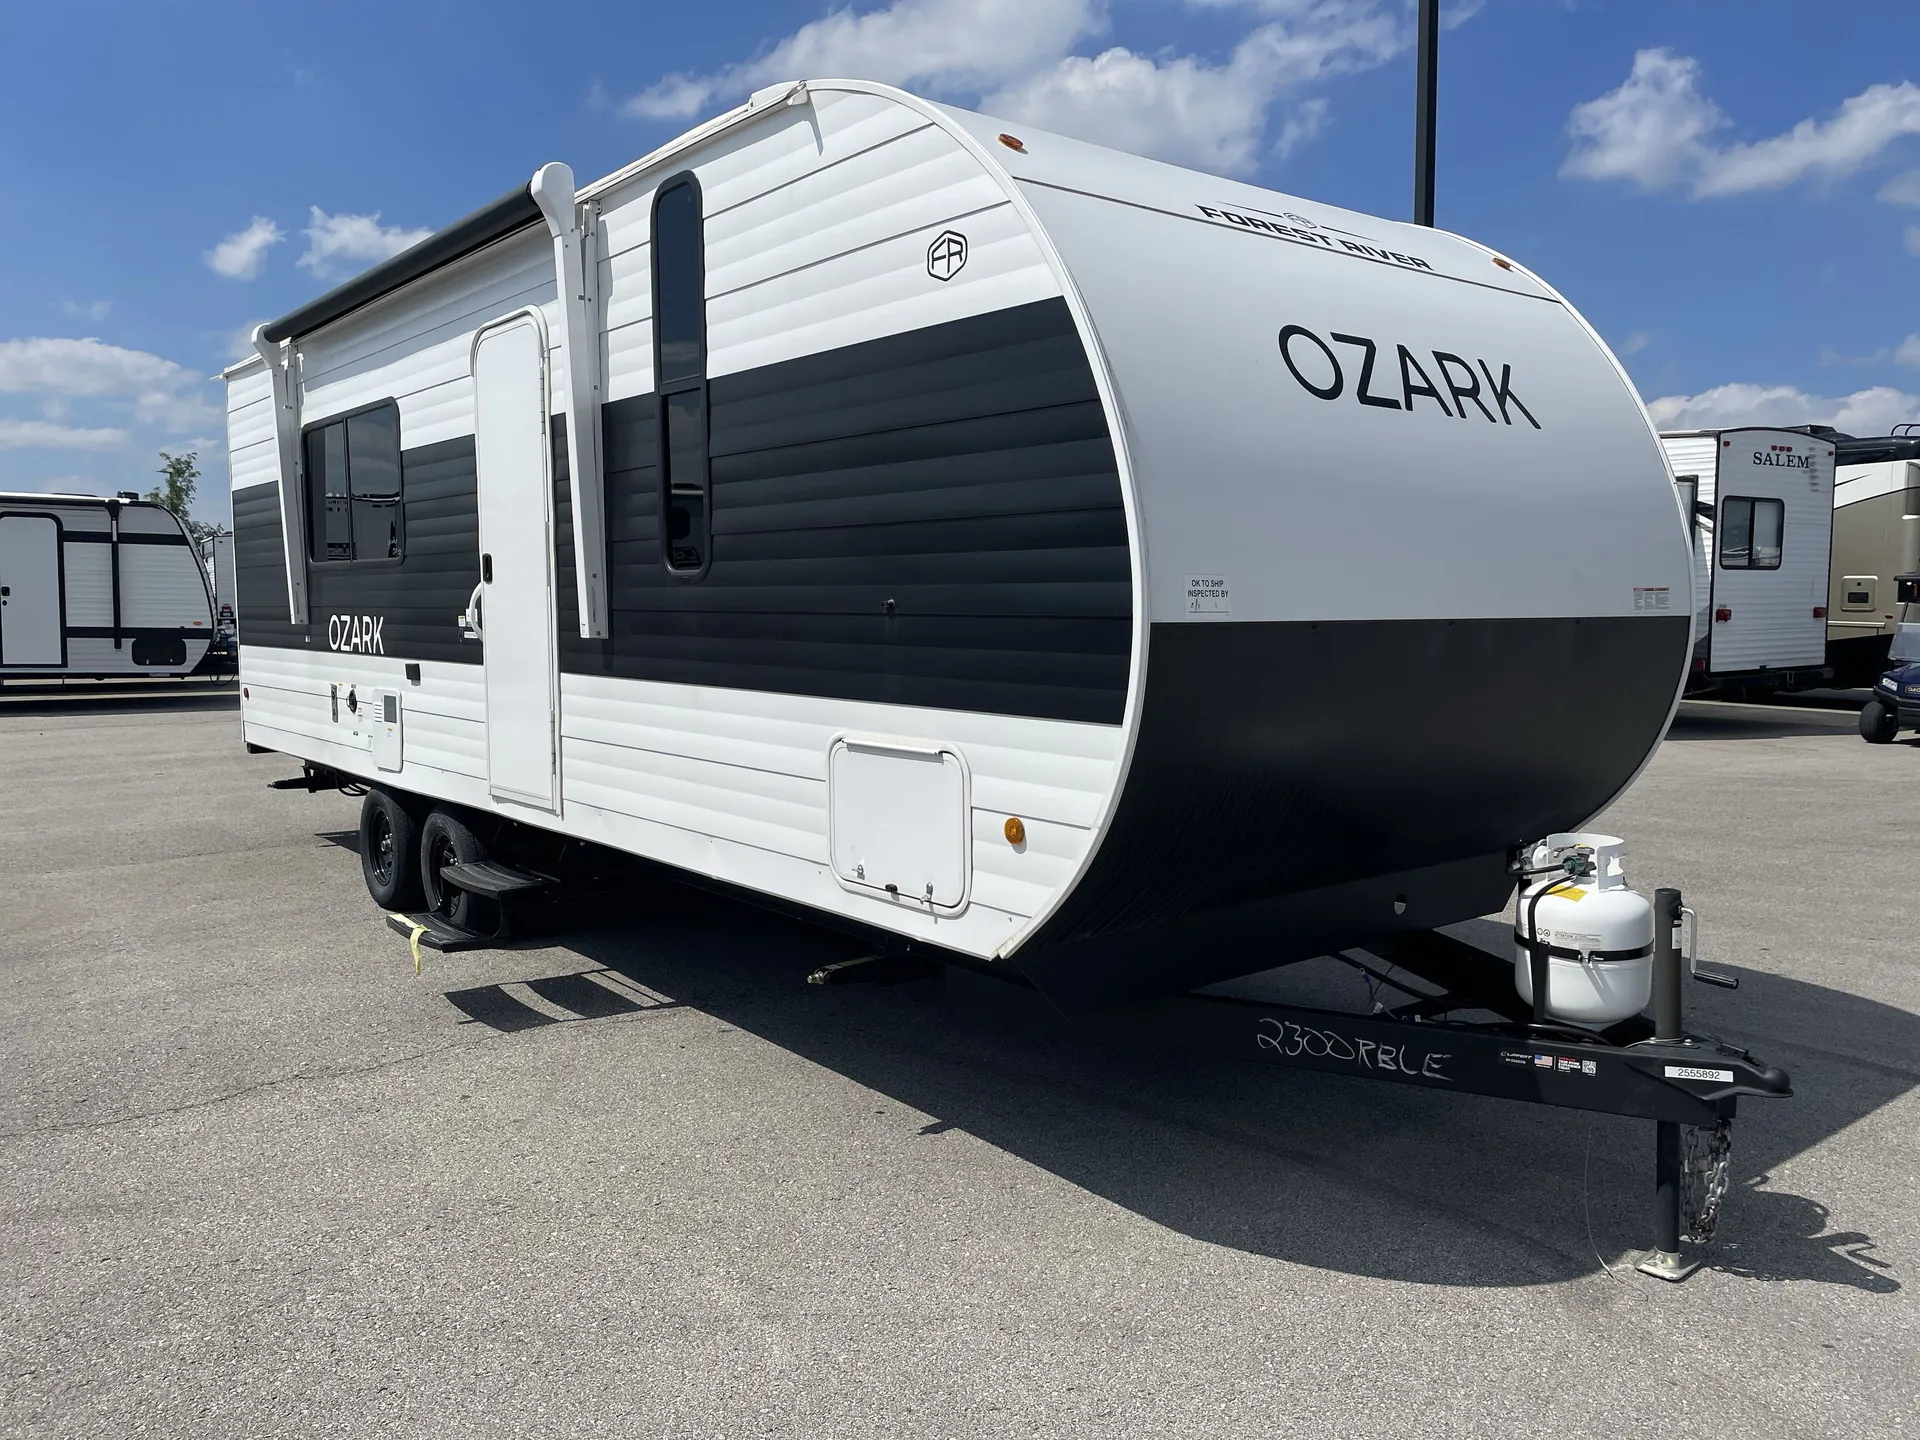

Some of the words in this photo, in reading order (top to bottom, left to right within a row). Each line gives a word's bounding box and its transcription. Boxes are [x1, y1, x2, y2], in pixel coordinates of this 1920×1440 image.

[1194, 203, 1333, 247] FOREST
[1336, 238, 1434, 271] RIVER
[1278, 324, 1541, 430] OZARK
[1752, 451, 1810, 469] SALEM
[1191, 579, 1201, 587] OK
[1201, 579, 1210, 587] TO
[1187, 589, 1220, 598] INSPECTED
[1220, 589, 1229, 598] BY
[328, 614, 384, 655] OZARK
[1677, 1068, 1721, 1080] 2555892
